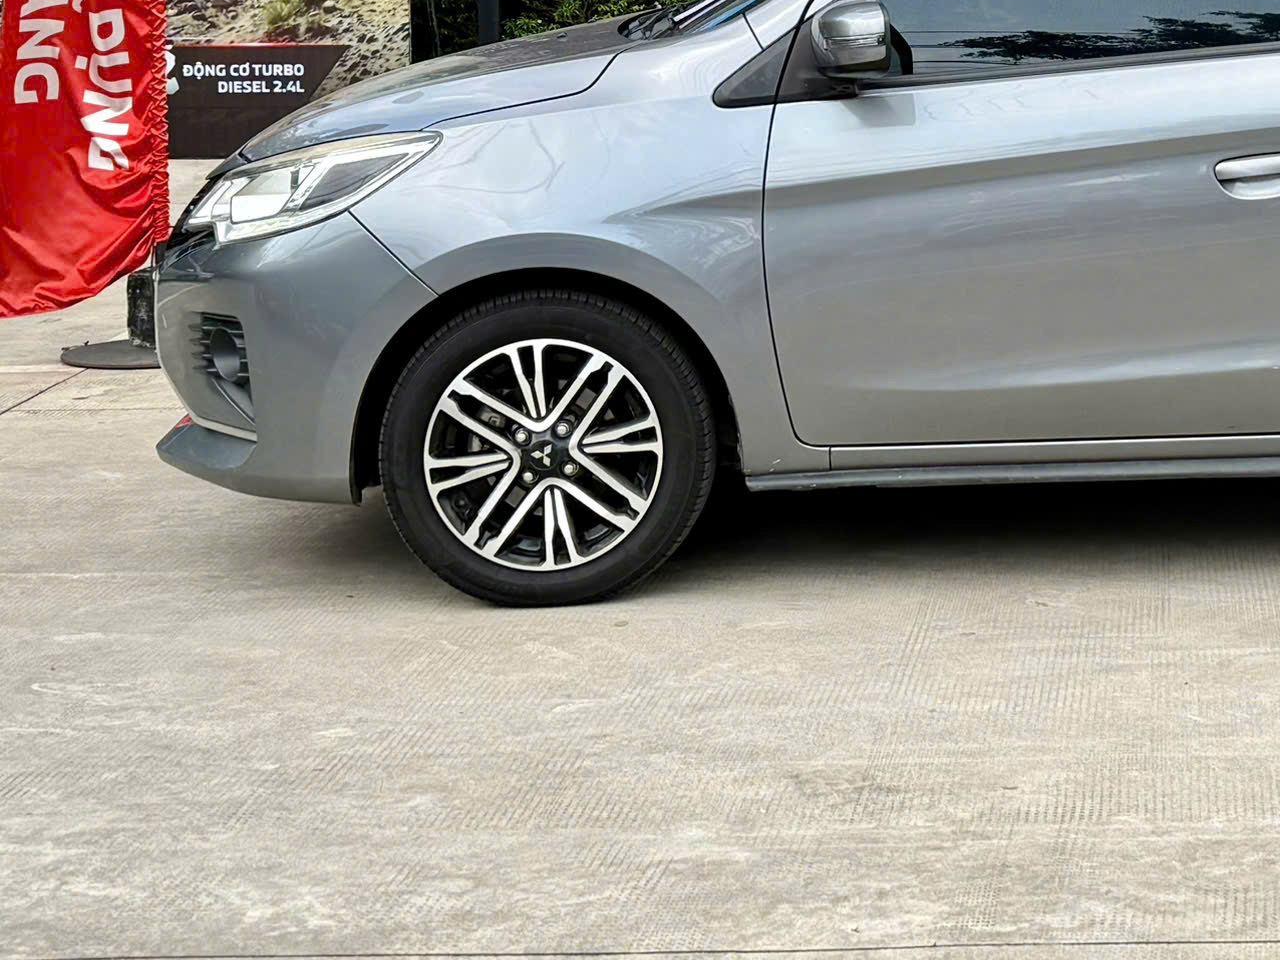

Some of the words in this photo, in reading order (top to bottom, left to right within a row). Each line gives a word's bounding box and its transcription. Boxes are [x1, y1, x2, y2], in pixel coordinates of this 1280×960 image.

[182, 62, 226, 80] ĐỘNG
[229, 62, 250, 77] CƠ
[252, 64, 305, 77] TURBO
[218, 81, 270, 93] DIESEL
[273, 81, 305, 93] 2.4L
